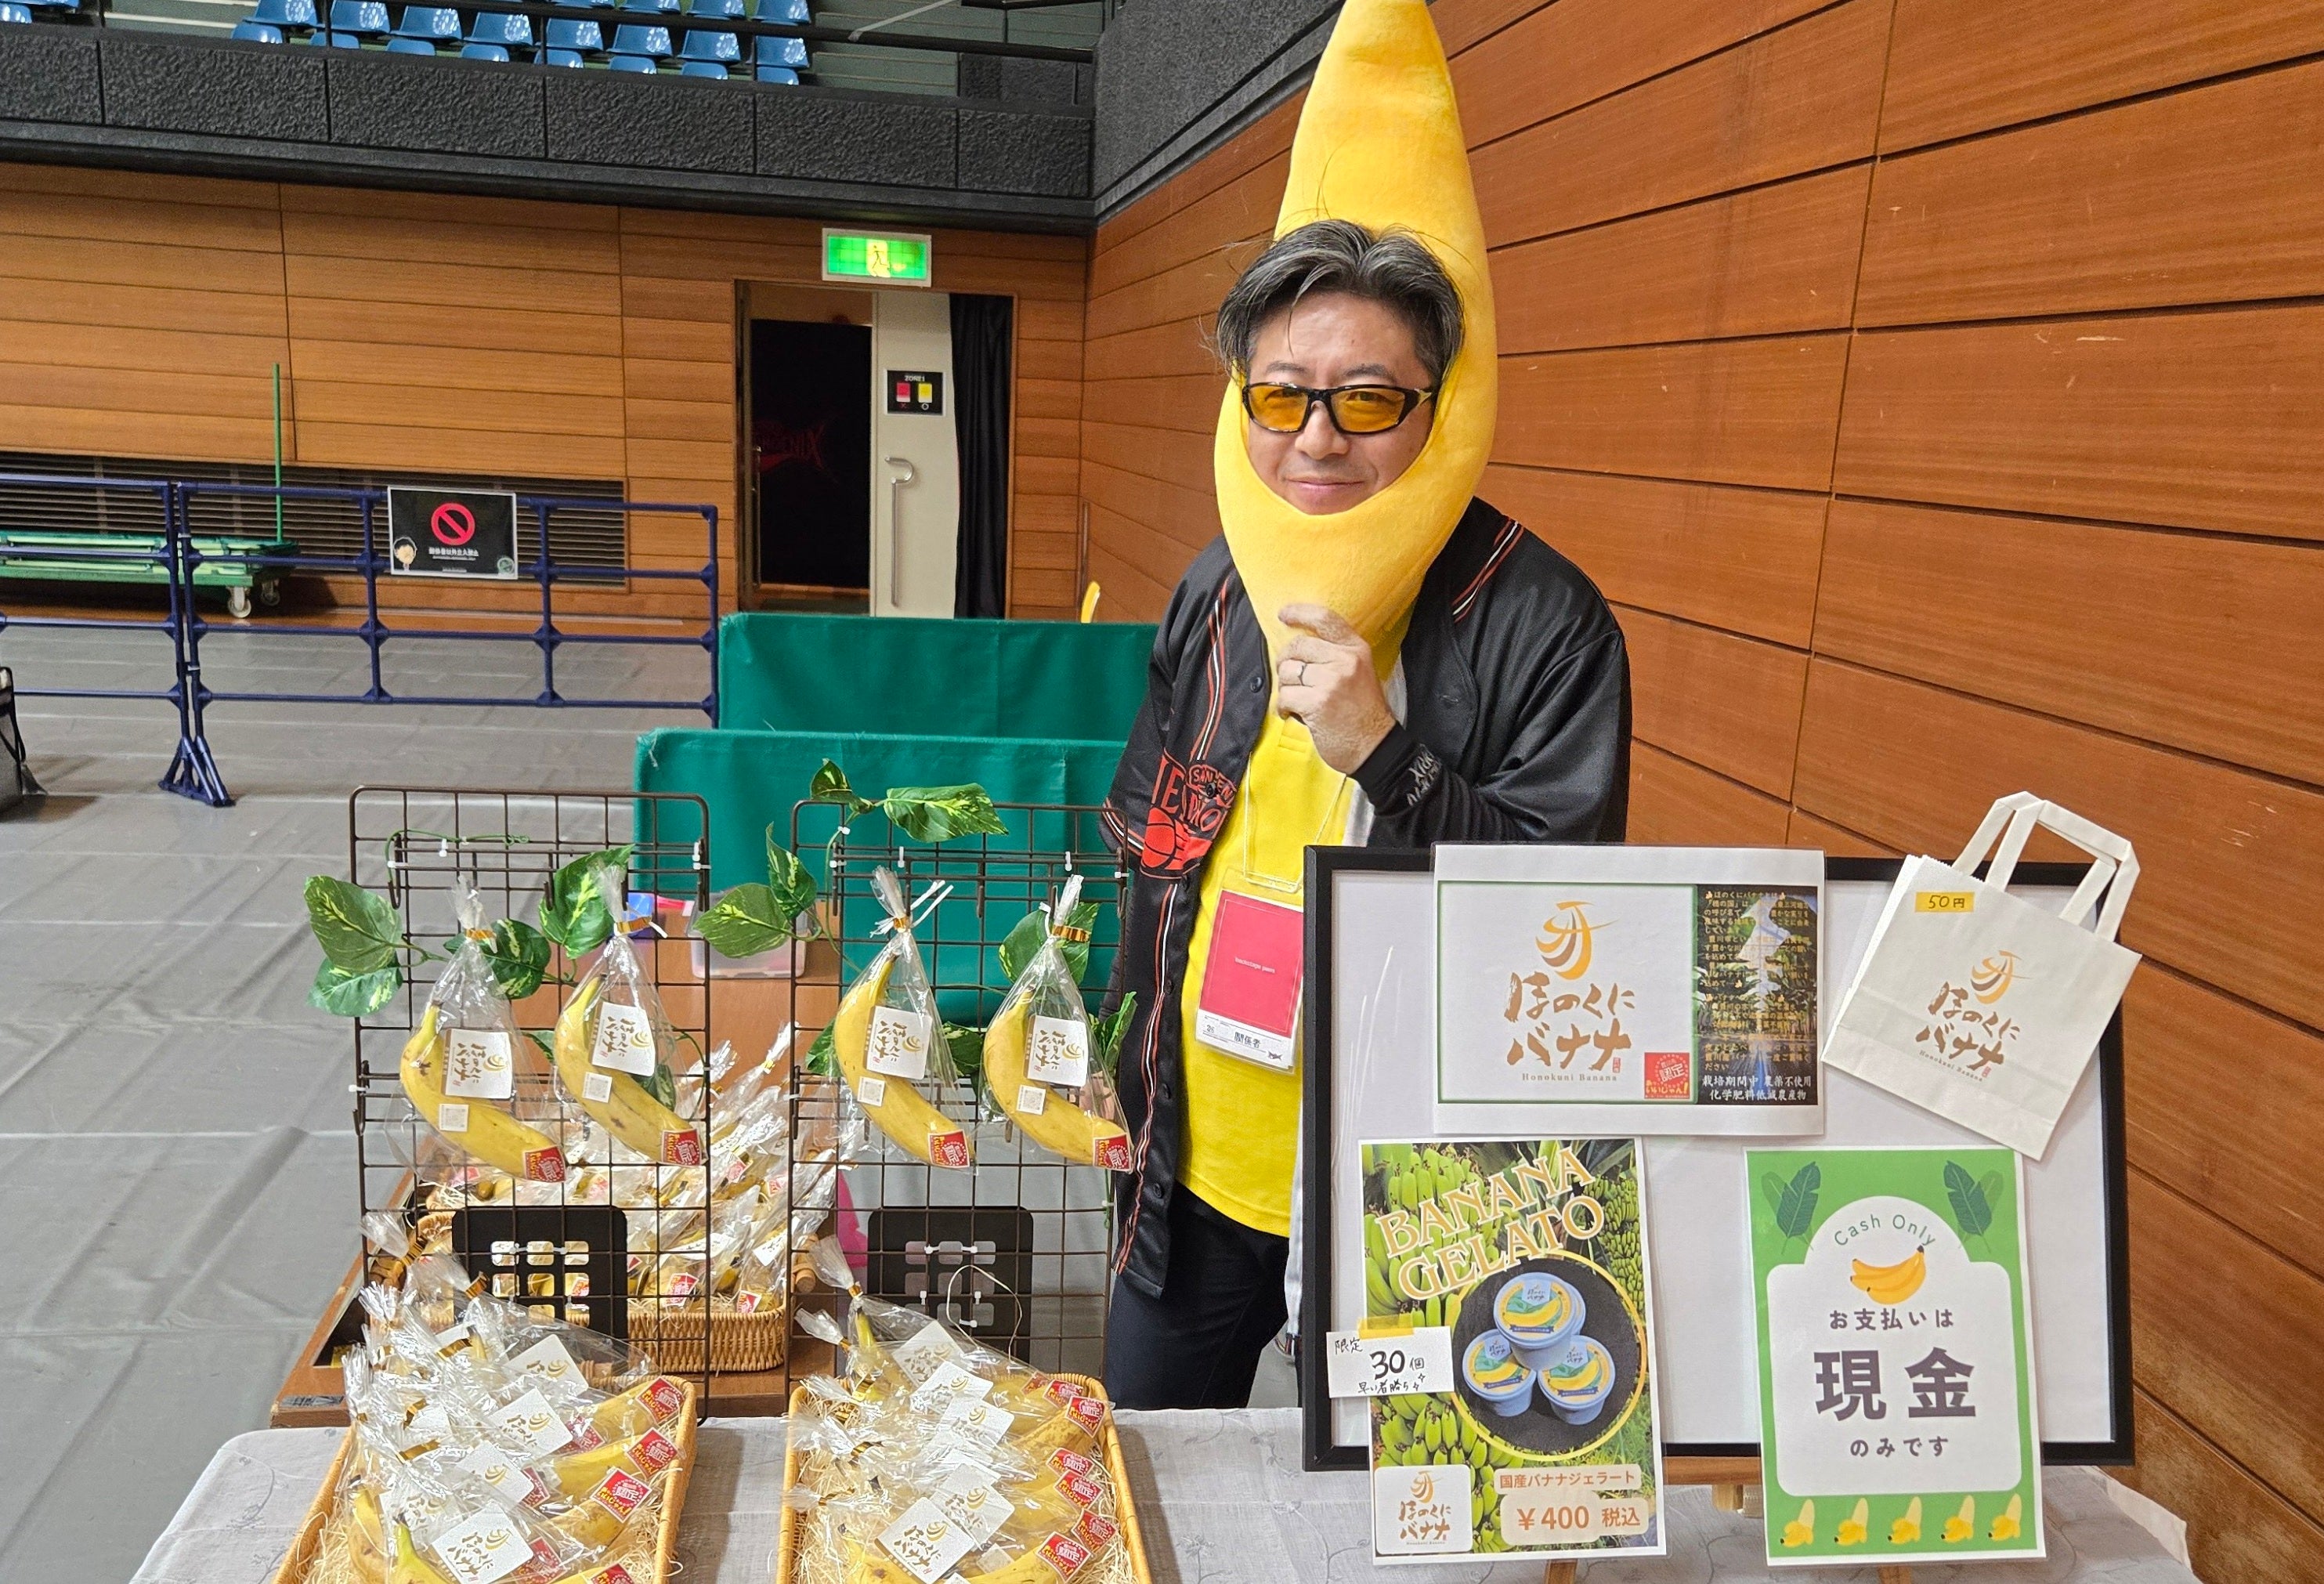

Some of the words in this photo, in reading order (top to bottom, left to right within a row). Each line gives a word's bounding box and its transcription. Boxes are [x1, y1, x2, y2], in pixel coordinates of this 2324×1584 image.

[1928, 895, 1964, 910] 50円
[1504, 971, 1635, 1022] ほのくに
[1928, 982, 2020, 1040] ほのくに
[1234, 1031, 1261, 1049] 関係者
[1507, 1018, 1632, 1072] バナナ
[1915, 1022, 2004, 1070] バナナ
[1377, 1147, 1596, 1259] BANANA
[1834, 1214, 1881, 1247] Cash
[1892, 1213, 1937, 1247] Only
[1399, 1195, 1604, 1301] GELATO
[1829, 1307, 1954, 1330] お支払いは
[1335, 1337, 1364, 1354] 限定
[1357, 1379, 1409, 1394] 早い者勝ち
[1813, 1347, 1976, 1421] 現金
[1850, 1436, 1950, 1459] のみです
[1499, 1470, 1635, 1488] 国産バナナジェラート
[1398, 1500, 1451, 1521] ほのくに
[1516, 1504, 1590, 1531] ¥400
[1602, 1506, 1640, 1528] 税込
[1400, 1518, 1451, 1540] バナナ
